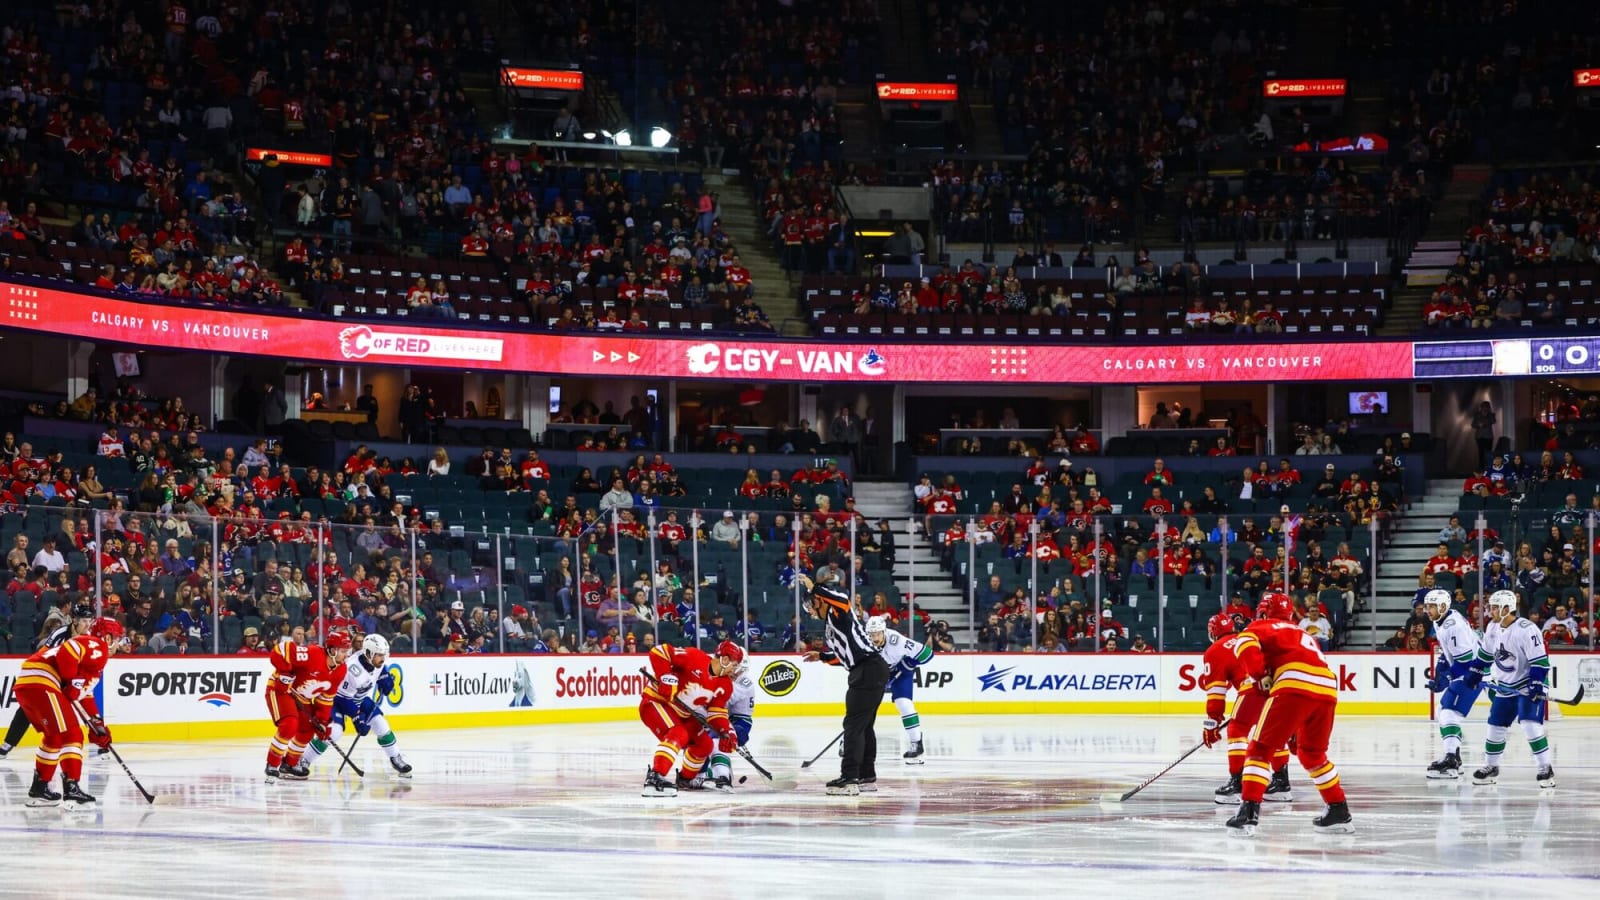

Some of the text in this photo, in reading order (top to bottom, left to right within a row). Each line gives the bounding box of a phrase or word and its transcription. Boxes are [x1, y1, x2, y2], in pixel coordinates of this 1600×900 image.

[91, 311, 269, 340] CALGARY VS. VANCOUVER
[373, 338, 392, 349] OF
[395, 338, 431, 353] RED
[1539, 344, 1554, 360] 0
[1103, 356, 1322, 370] CALGARY VS. VANCOUVER
[1565, 345, 1588, 365] 0
[904, 641, 915, 651] 73
[1451, 636, 1457, 647] 7
[296, 645, 309, 662] 22
[117, 671, 262, 697] SPORTSNET
[763, 668, 796, 686] mike's
[1012, 674, 1156, 691] PLAYALBERTA
